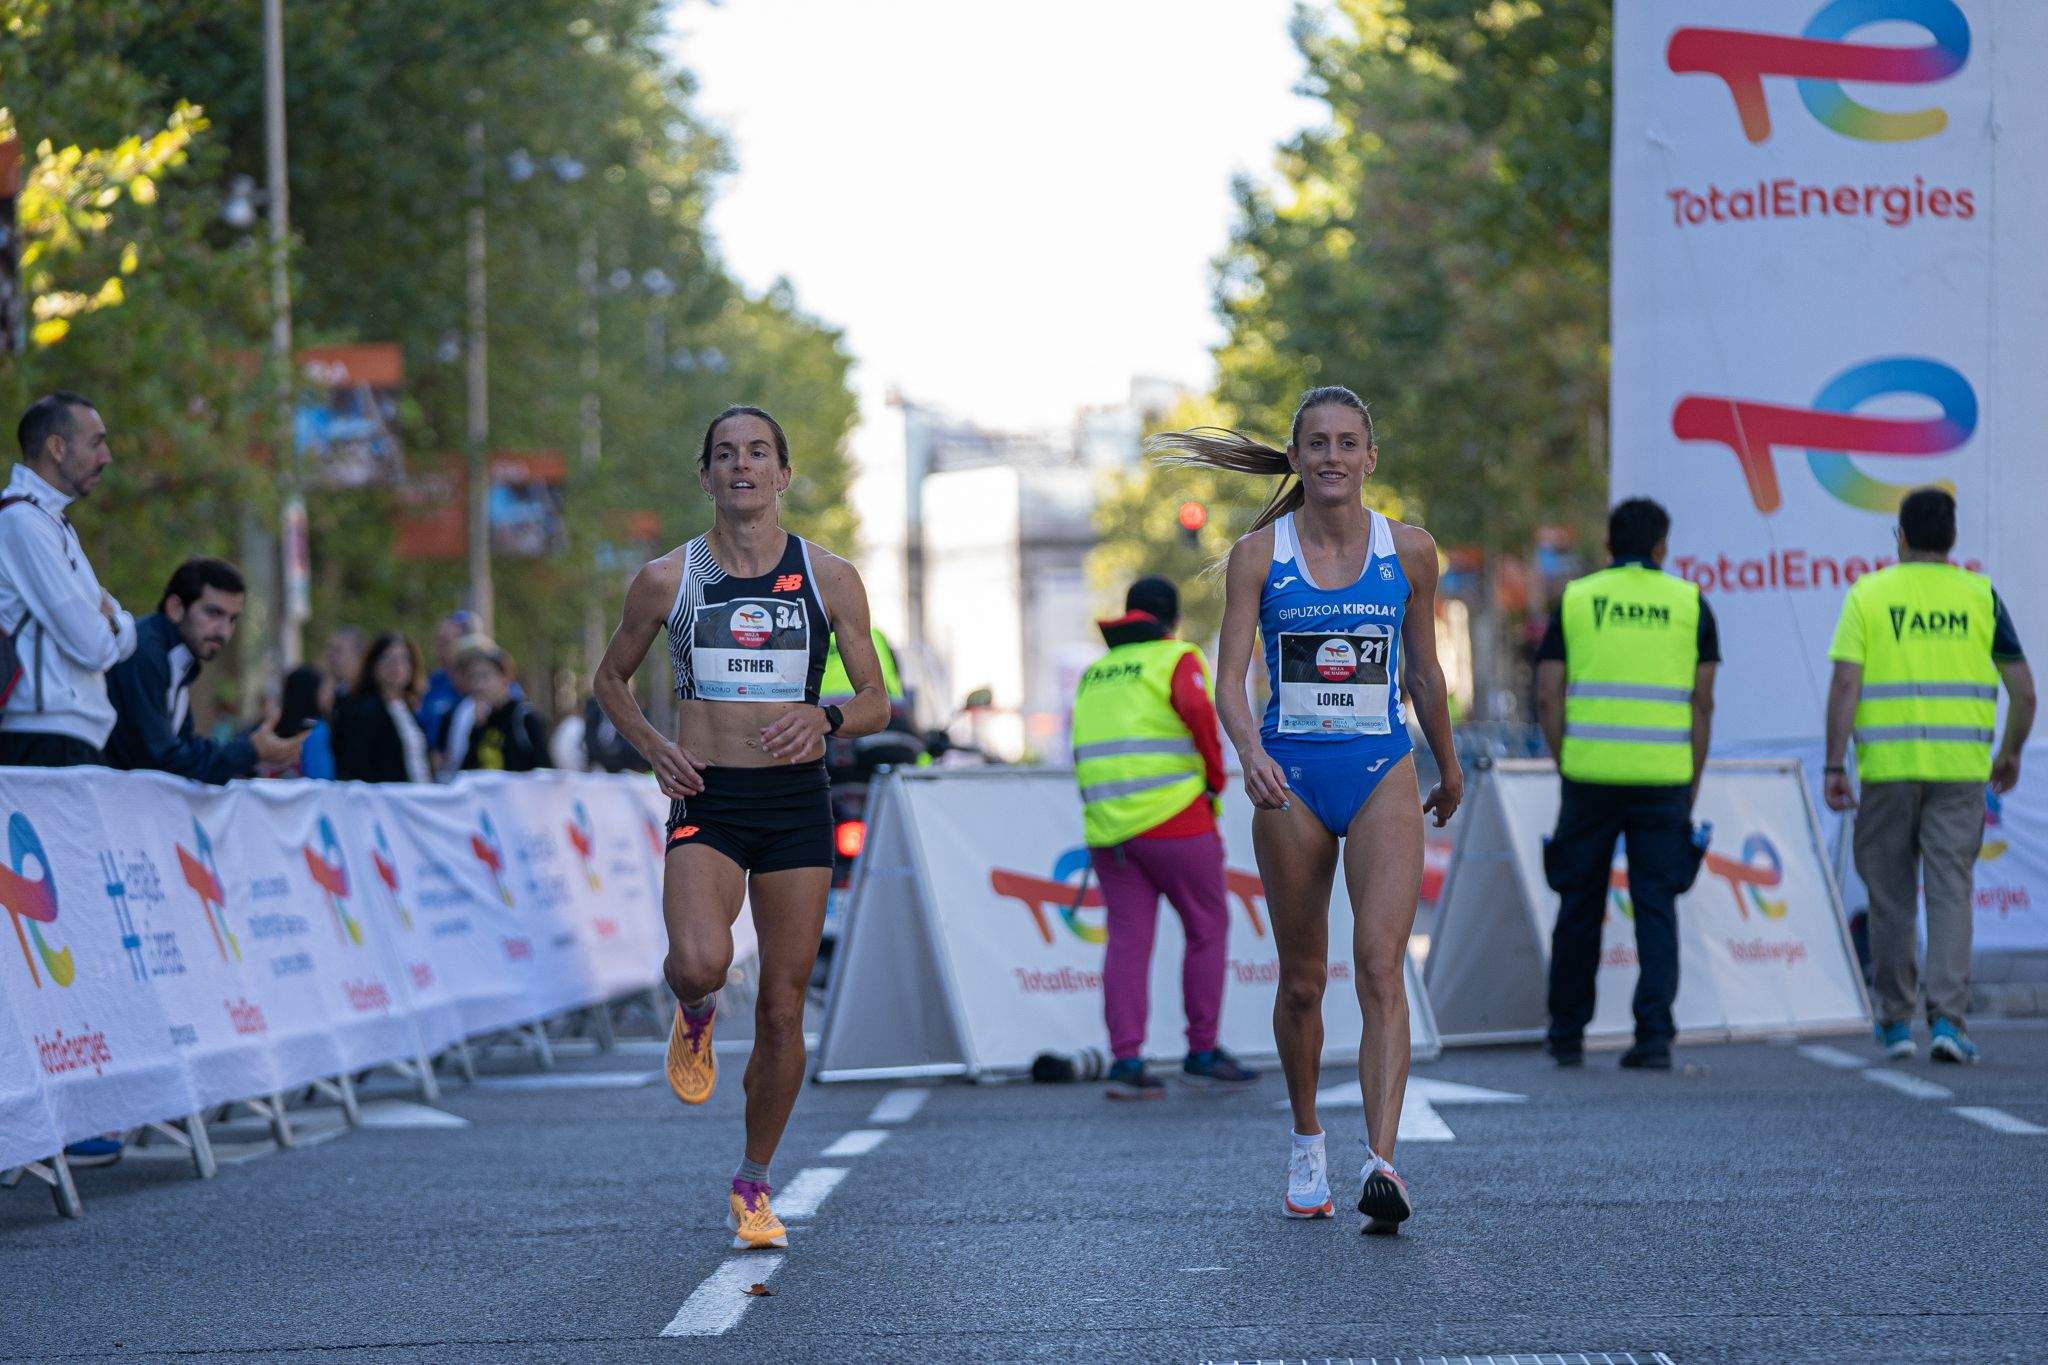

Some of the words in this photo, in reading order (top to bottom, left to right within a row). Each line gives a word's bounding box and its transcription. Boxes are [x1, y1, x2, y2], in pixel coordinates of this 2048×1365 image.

[1668, 176, 1976, 228] TotalEnergies
[1675, 548, 1984, 593] TotalEner
[776, 605, 802, 630] 34
[1279, 604, 1340, 620] GIPUZKOA
[1343, 603, 1397, 617] KIROLAK
[1609, 603, 1670, 621] ADM
[1909, 611, 1968, 631] ADM
[1360, 640, 1384, 663] 21
[728, 658, 774, 673] ESTHER
[1317, 692, 1355, 707] LOREA
